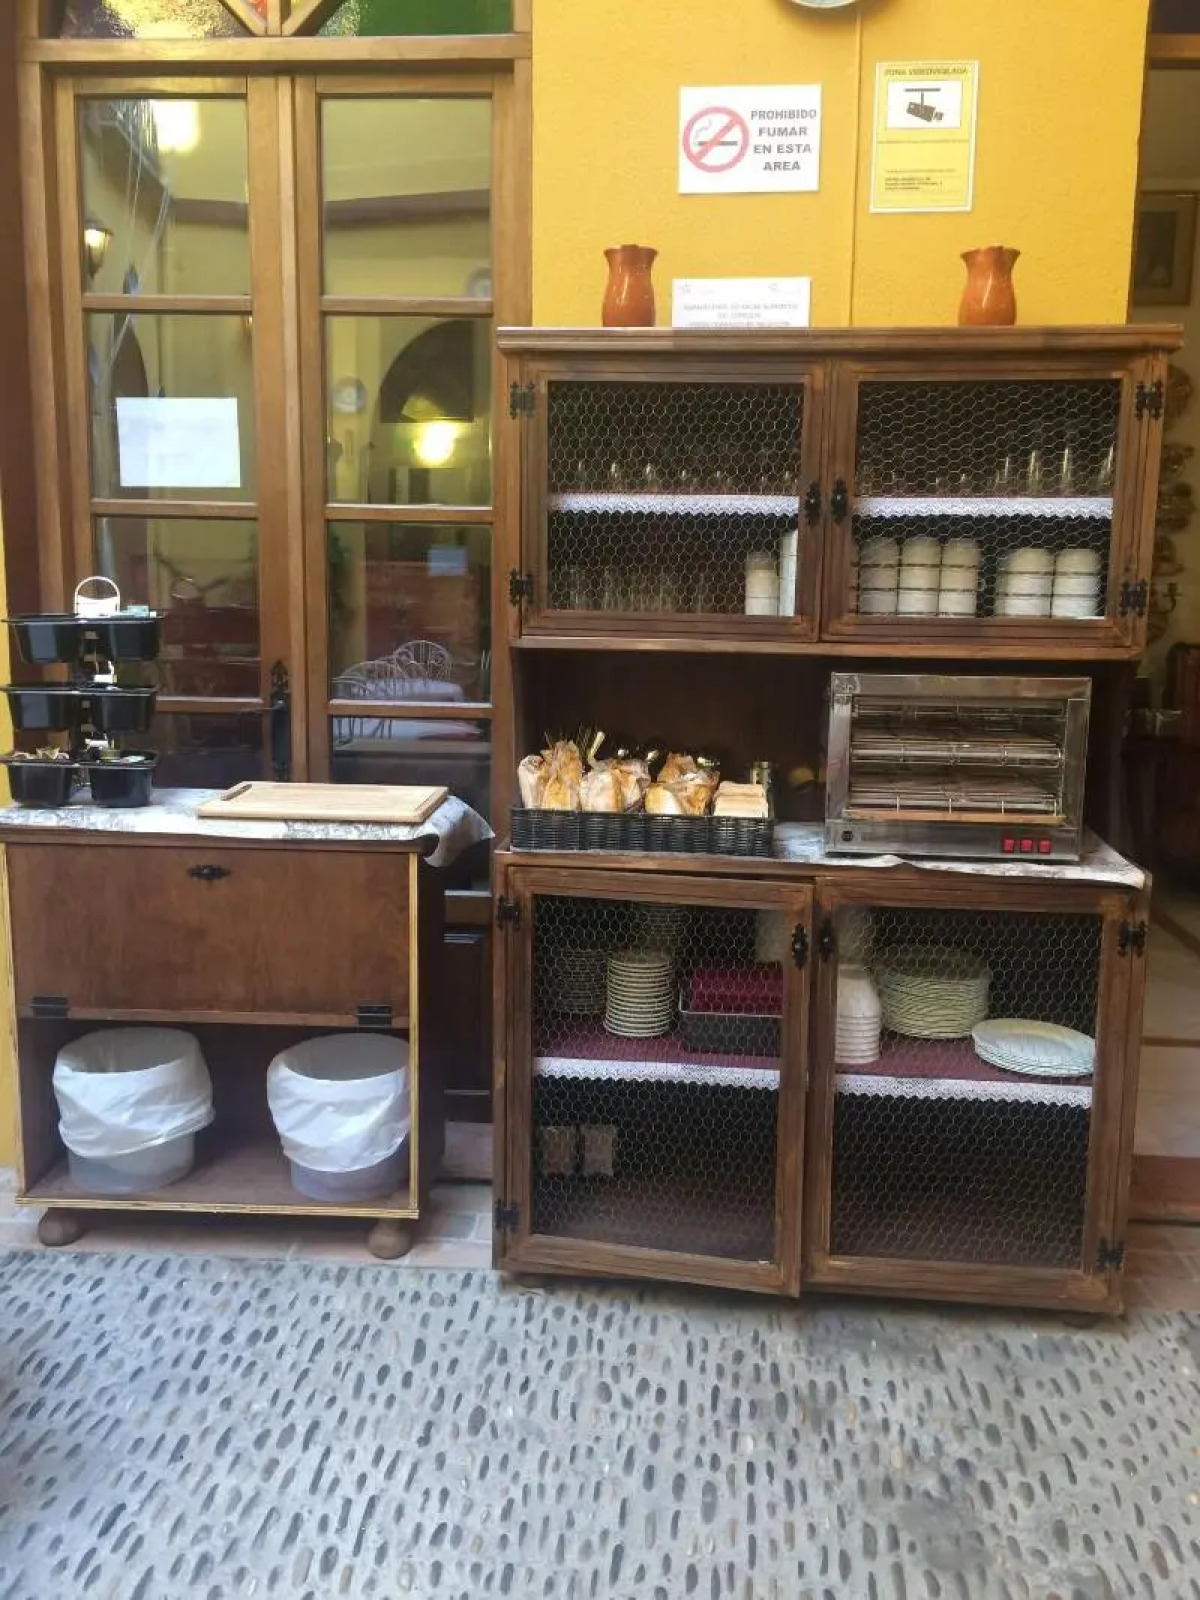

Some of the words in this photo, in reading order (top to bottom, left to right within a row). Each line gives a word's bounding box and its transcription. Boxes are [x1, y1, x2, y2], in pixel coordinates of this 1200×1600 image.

[751, 109, 817, 120] PROHIBIDO
[758, 126, 808, 137] FUMAR
[753, 144, 772, 154] EN
[776, 143, 812, 154] ESTA
[762, 161, 801, 171] AREA
